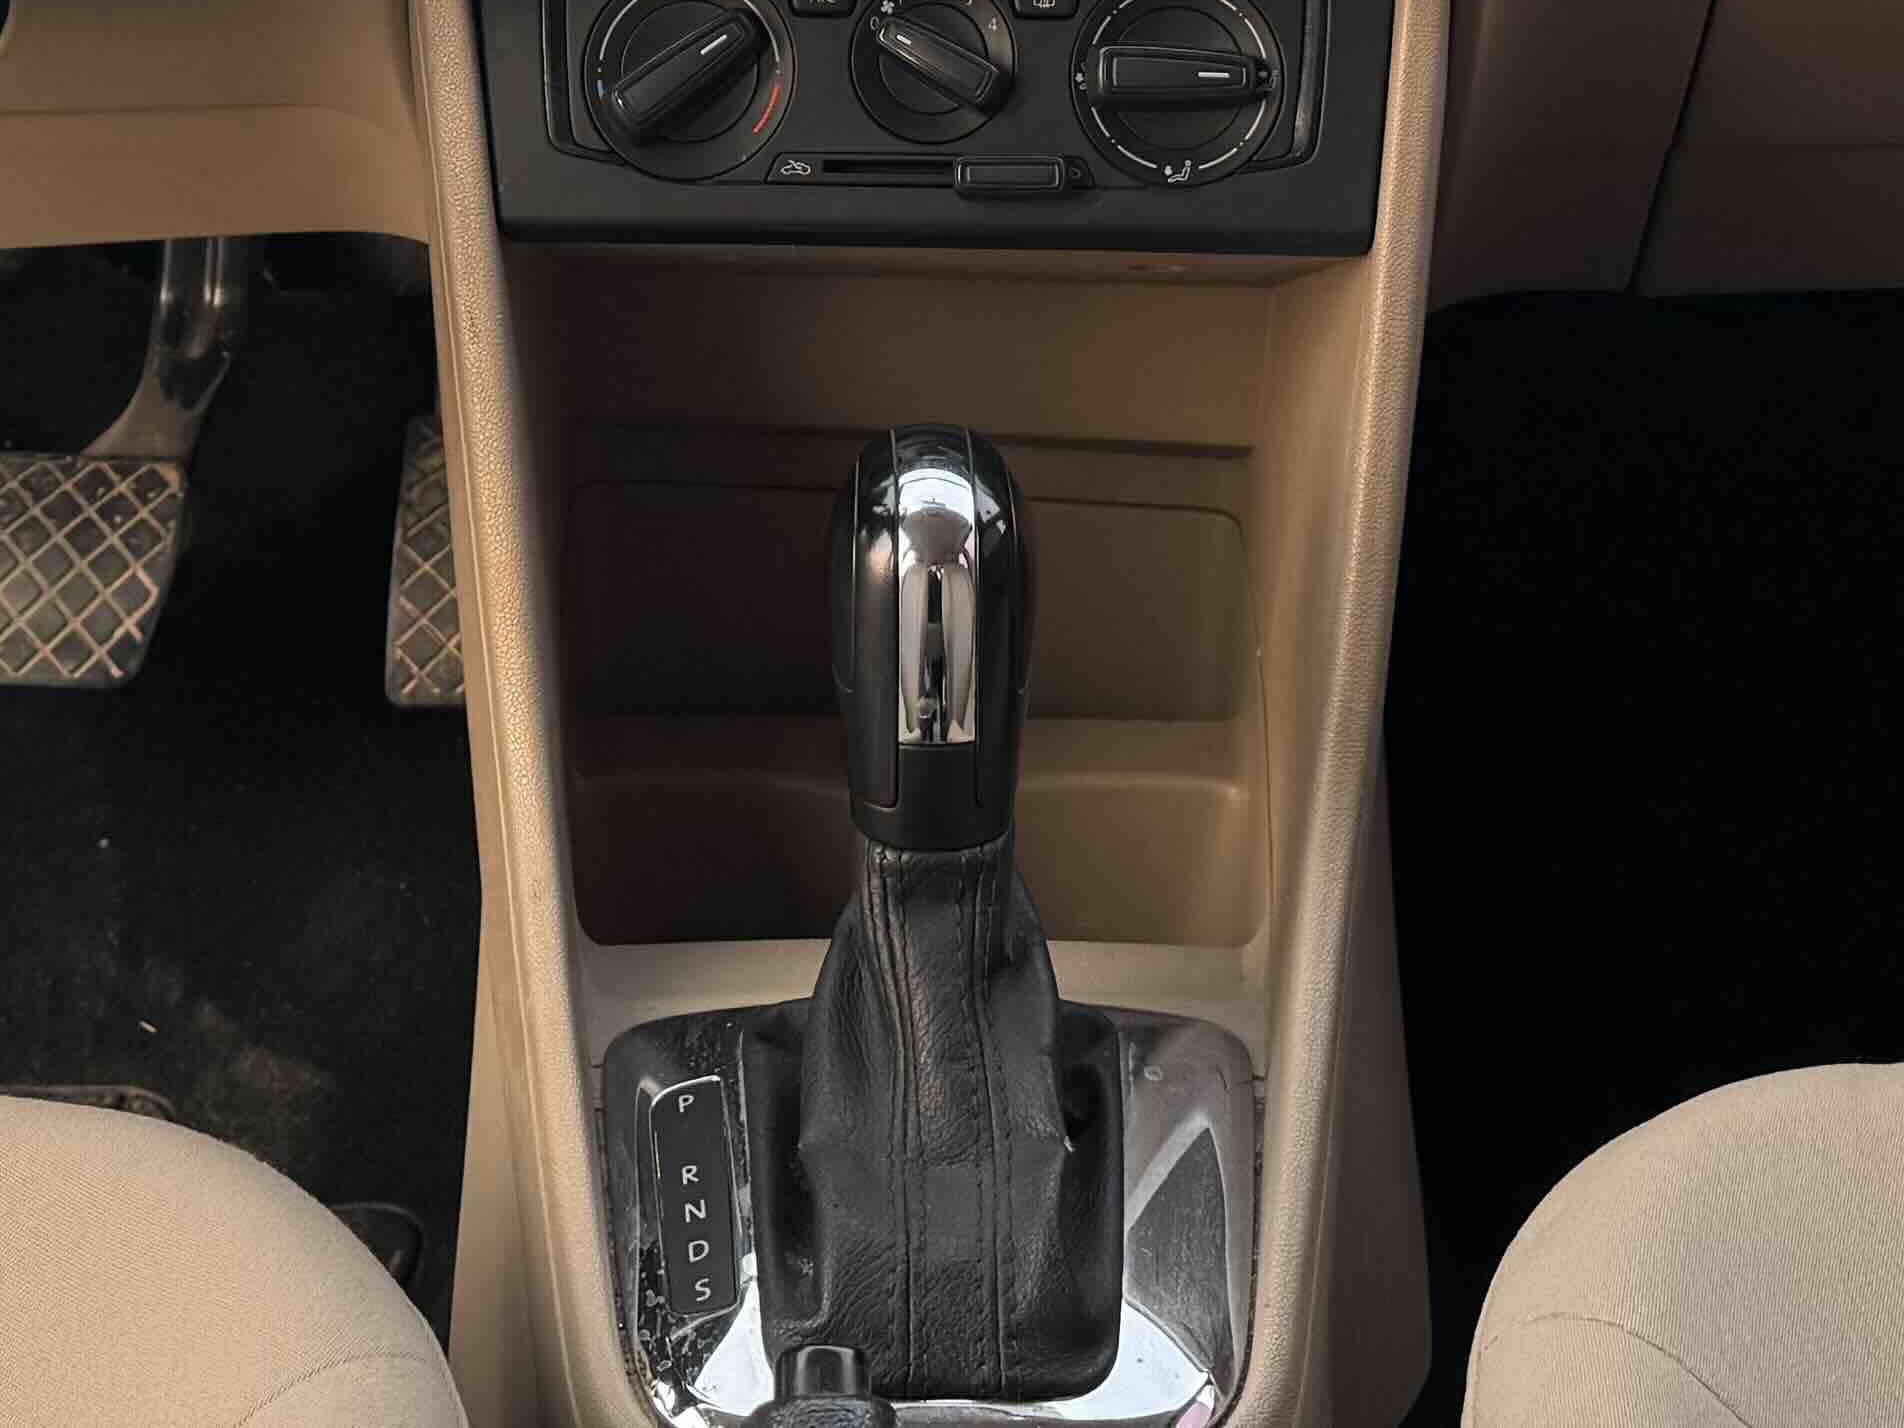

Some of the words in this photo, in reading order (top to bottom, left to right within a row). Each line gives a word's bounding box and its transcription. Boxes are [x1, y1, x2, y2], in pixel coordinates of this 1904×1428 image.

[988, 16, 998, 31] 4
[678, 1094, 694, 1113] P
[681, 1165, 700, 1184] R
[684, 1199, 707, 1223] N
[688, 1240, 710, 1262] D
[695, 1278, 711, 1301] S
